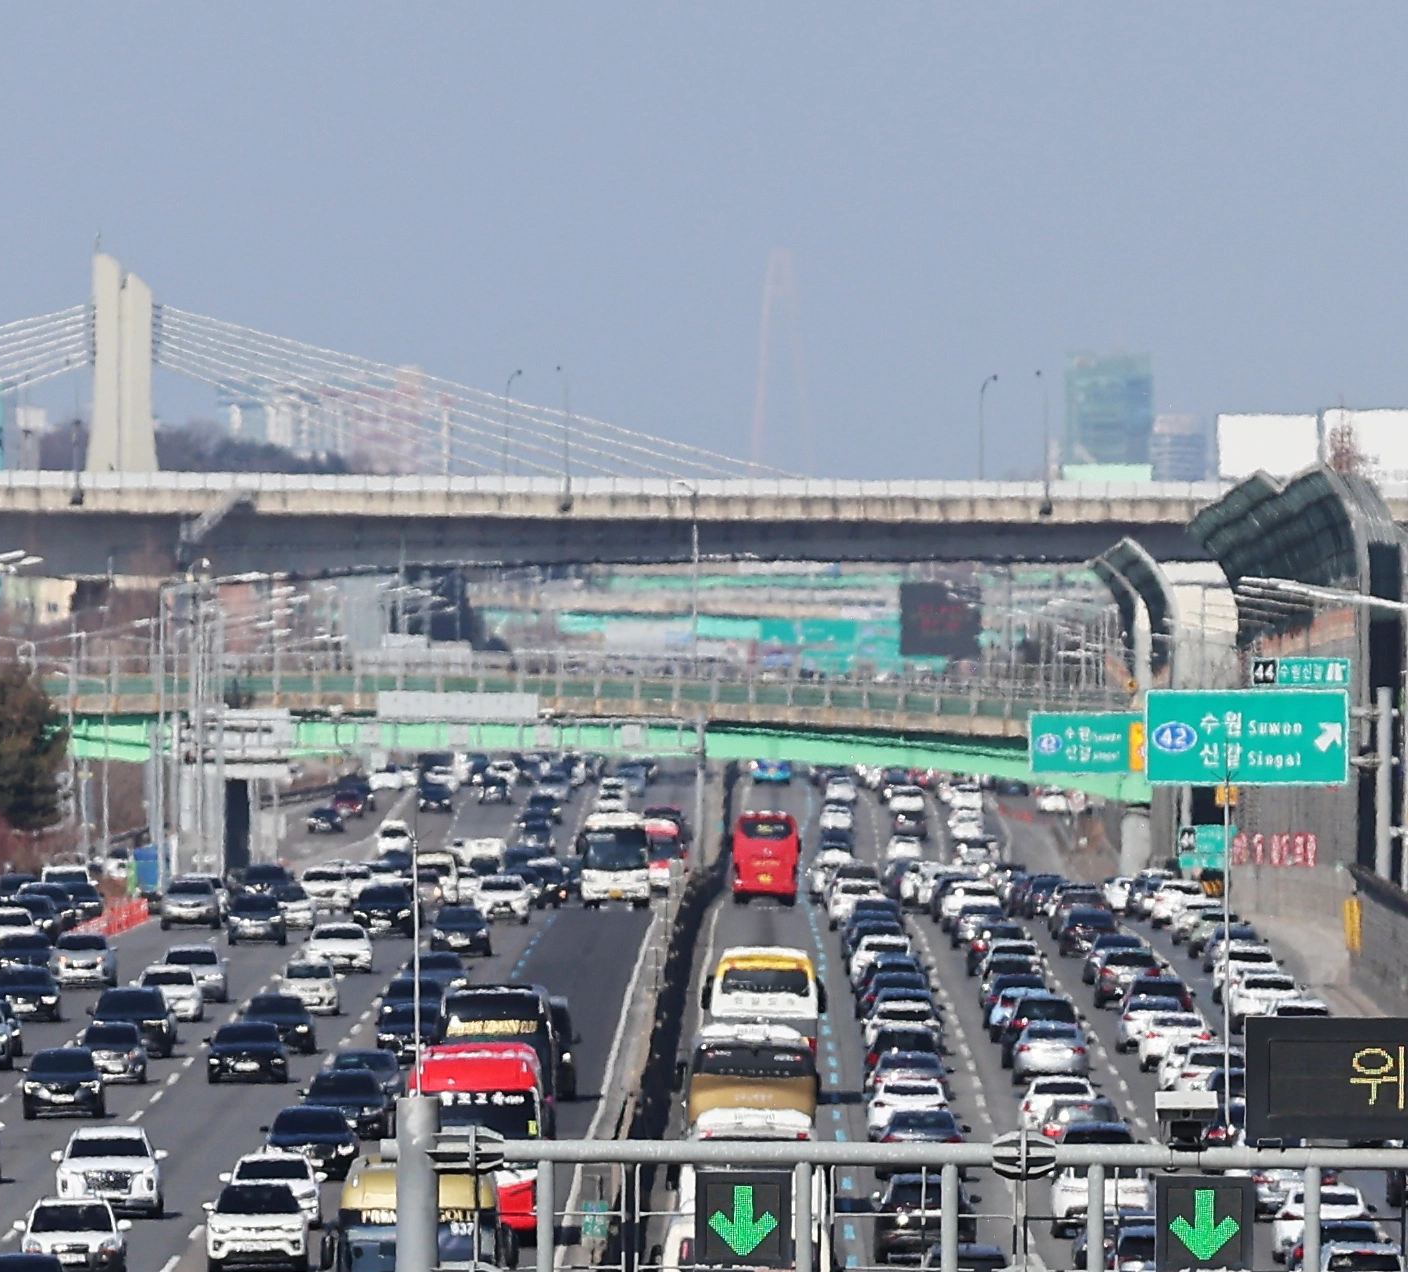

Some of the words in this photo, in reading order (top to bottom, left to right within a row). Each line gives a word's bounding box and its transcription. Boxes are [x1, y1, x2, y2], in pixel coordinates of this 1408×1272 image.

[1160, 727, 1188, 746] 42
[1200, 711, 1243, 738] 수원
[1248, 720, 1303, 736] Suwon
[1200, 743, 1243, 768] 신갈
[1248, 751, 1302, 768] Singal
